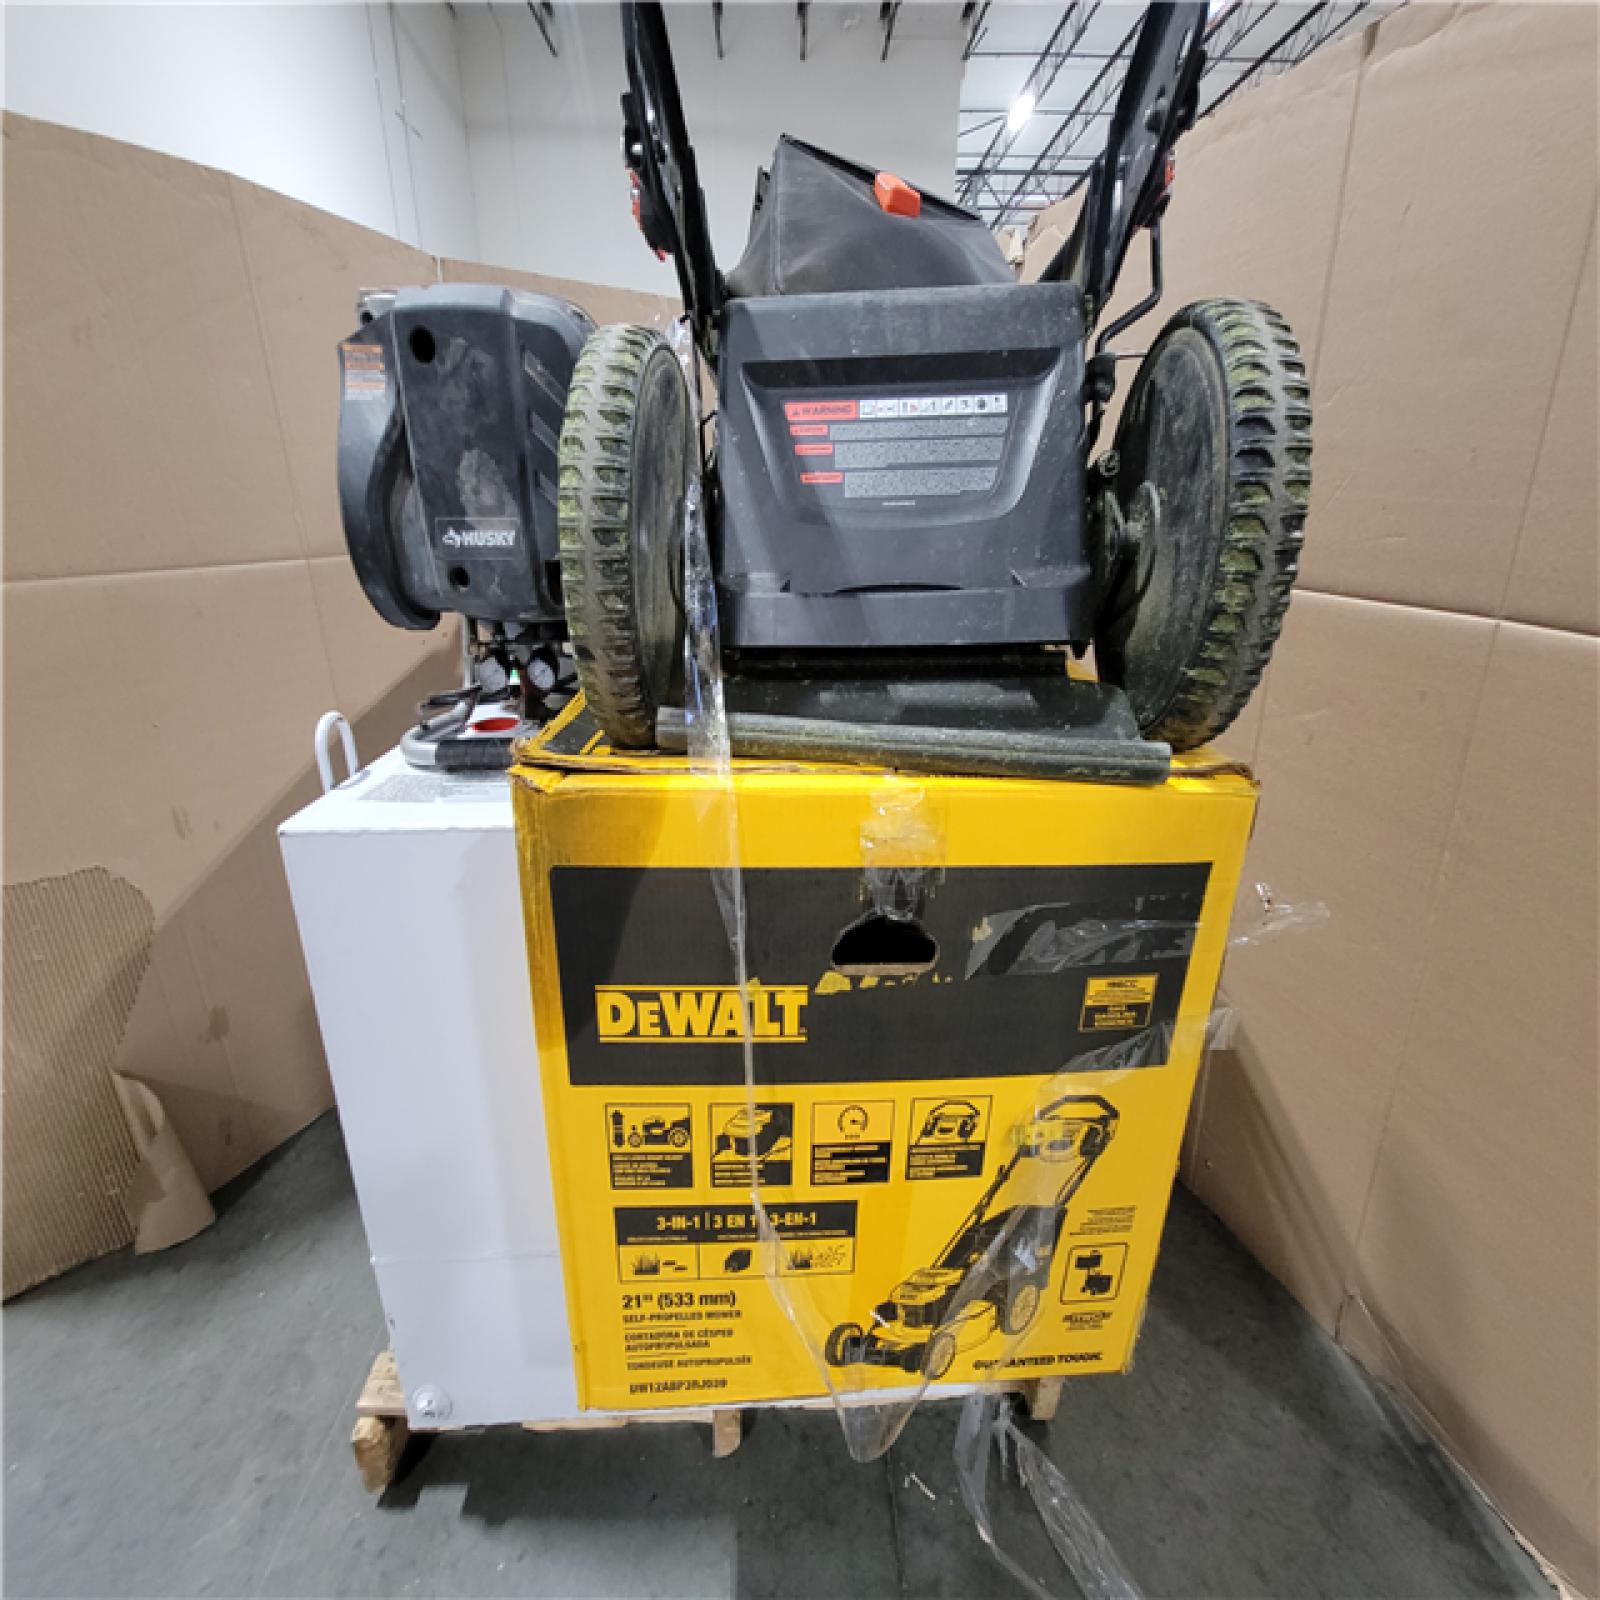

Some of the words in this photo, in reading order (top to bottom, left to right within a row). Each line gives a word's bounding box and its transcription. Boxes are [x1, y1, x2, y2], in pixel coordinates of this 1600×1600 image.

[461, 529, 516, 546] HUSKY
[656, 1214, 701, 1231] 3-IN-1
[712, 1213, 723, 1229] 3
[726, 1212, 746, 1229] EN
[657, 1291, 695, 1310] (533
[698, 1289, 736, 1308] mm)
